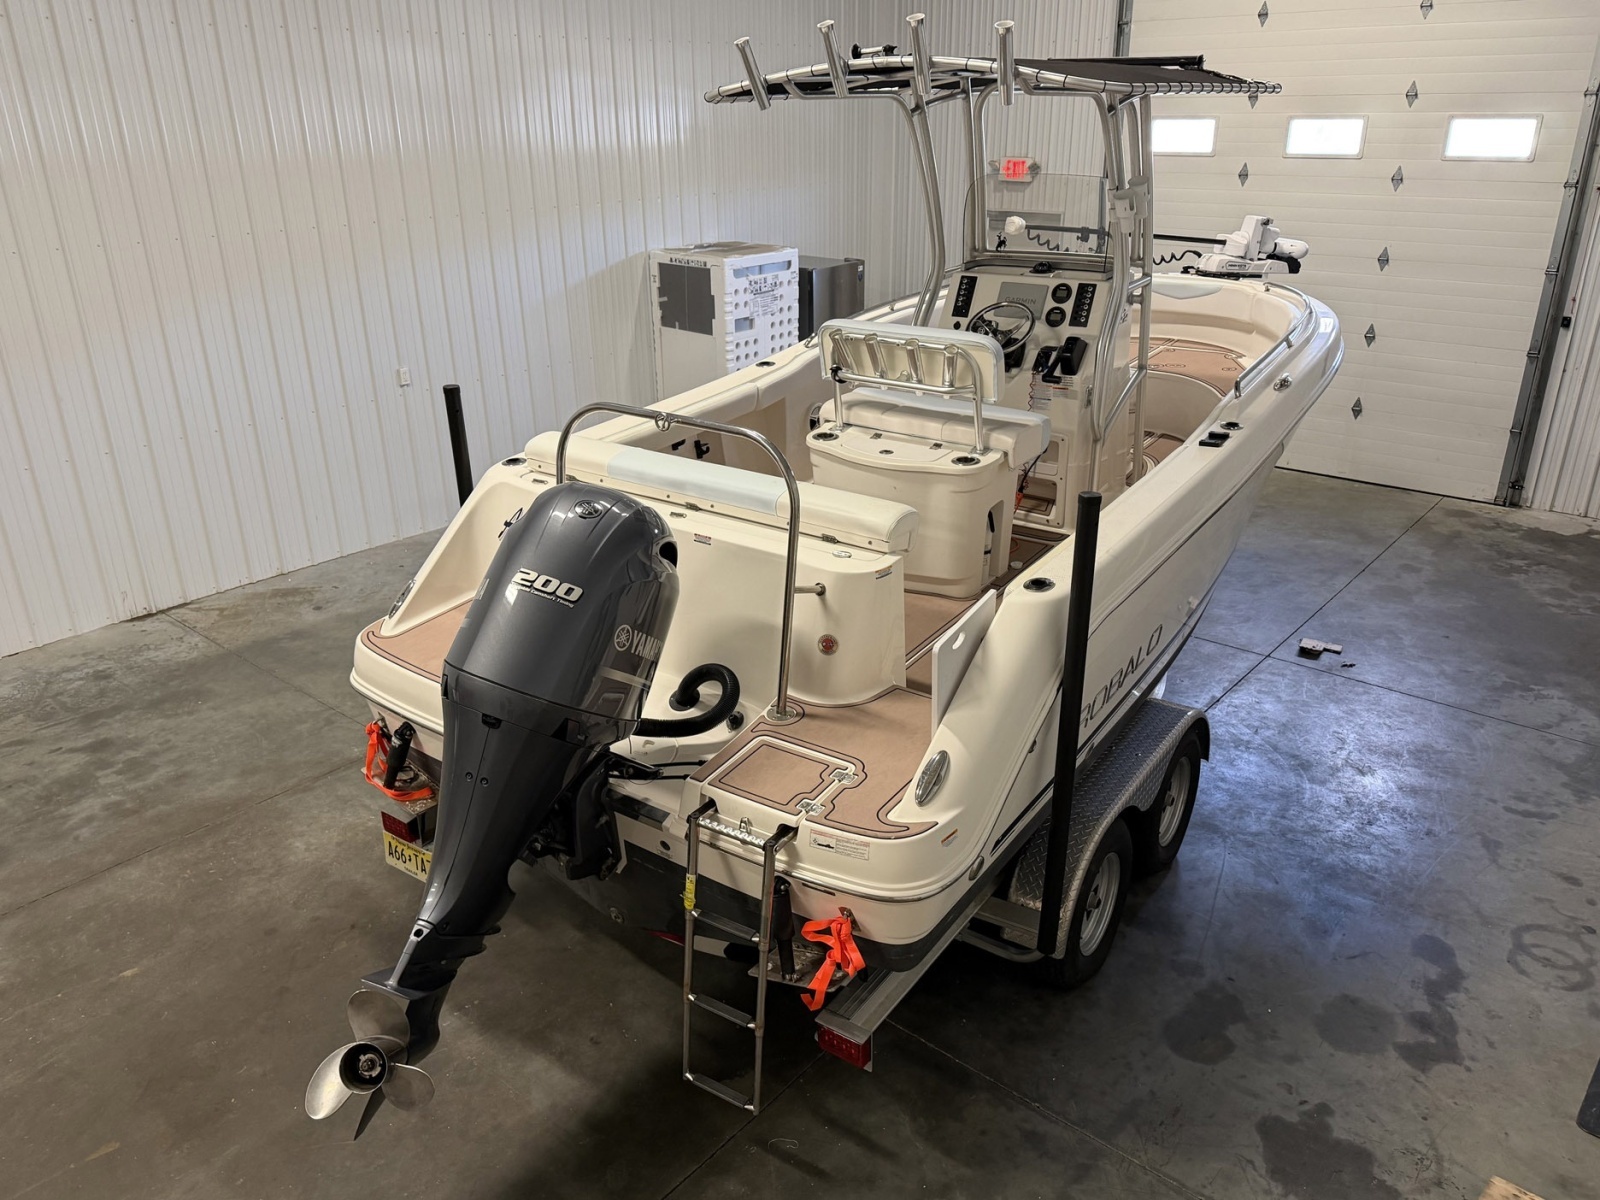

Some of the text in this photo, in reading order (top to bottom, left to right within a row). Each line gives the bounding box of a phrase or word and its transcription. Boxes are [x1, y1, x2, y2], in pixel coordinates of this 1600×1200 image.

[1006, 159, 1026, 178] EXIT
[511, 567, 583, 602] 200
[631, 630, 661, 661] YAMA
[1080, 624, 1163, 728] ROBALO
